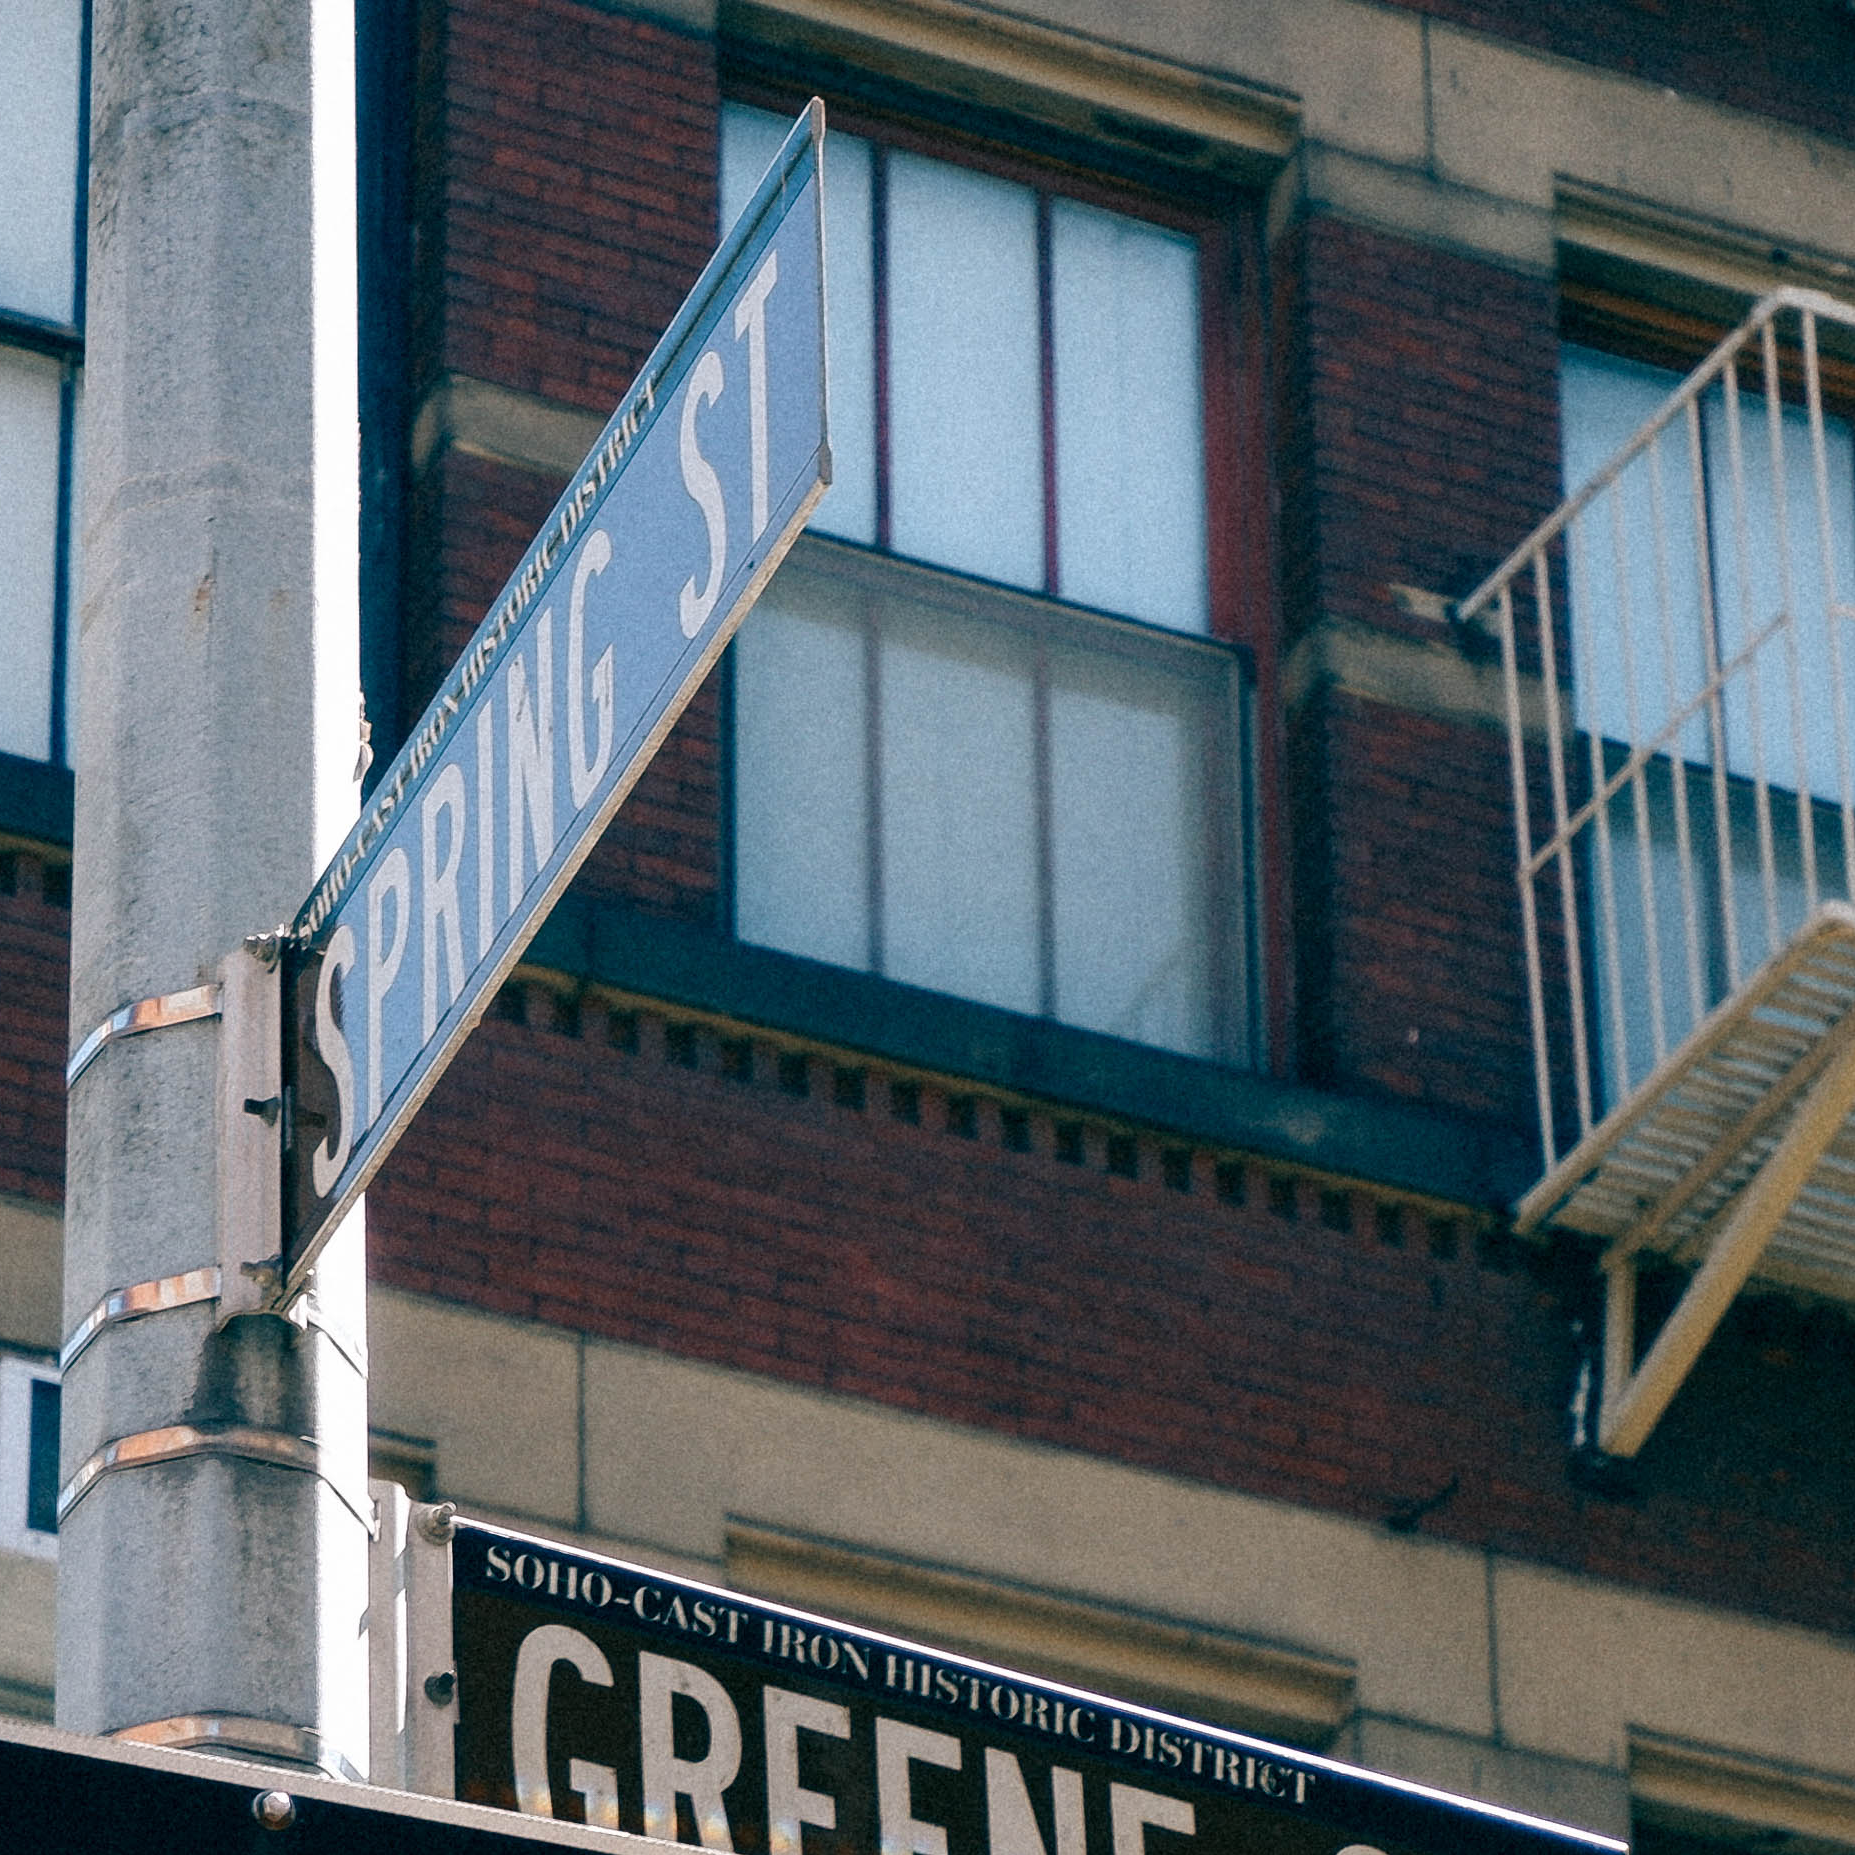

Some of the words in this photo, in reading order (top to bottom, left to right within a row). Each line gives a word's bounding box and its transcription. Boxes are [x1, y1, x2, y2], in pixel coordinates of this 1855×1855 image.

[313, 529, 613, 1199] SPRING
[678, 250, 779, 640] ST
[409, 684, 459, 779] IRON
[461, 531, 557, 698] HISTORIC
[560, 370, 656, 544] DISTRICT
[485, 1545, 749, 1643] SOHO-CAST
[763, 1619, 870, 1681] IRON
[886, 1654, 1095, 1742] HISTORIC
[1111, 1717, 1315, 1804] DISTRICT
